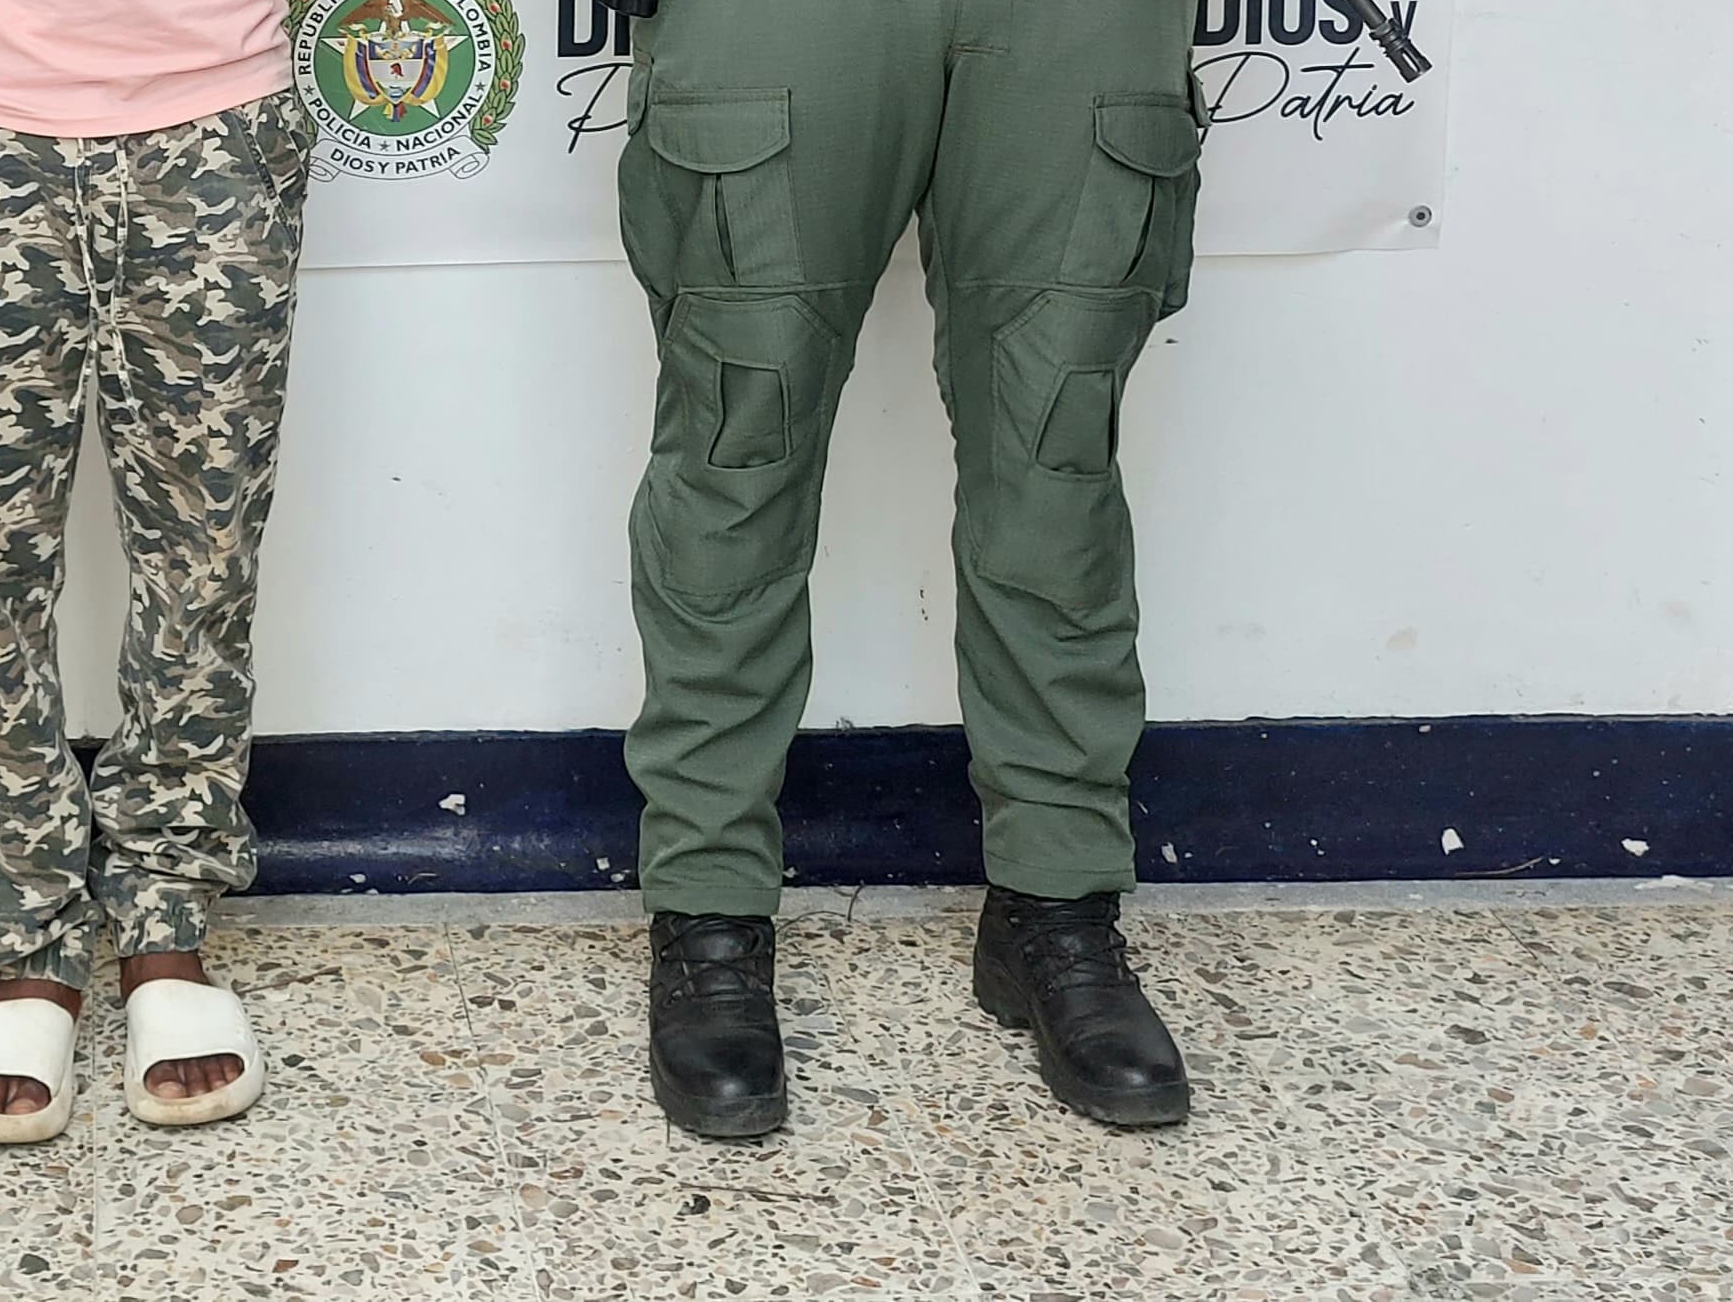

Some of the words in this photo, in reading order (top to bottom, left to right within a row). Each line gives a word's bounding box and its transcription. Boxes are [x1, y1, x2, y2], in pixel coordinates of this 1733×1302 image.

[397, 95, 482, 151] NACIONAL
[1193, 47, 1415, 146] Patria
[396, 147, 460, 174] PATRIA
